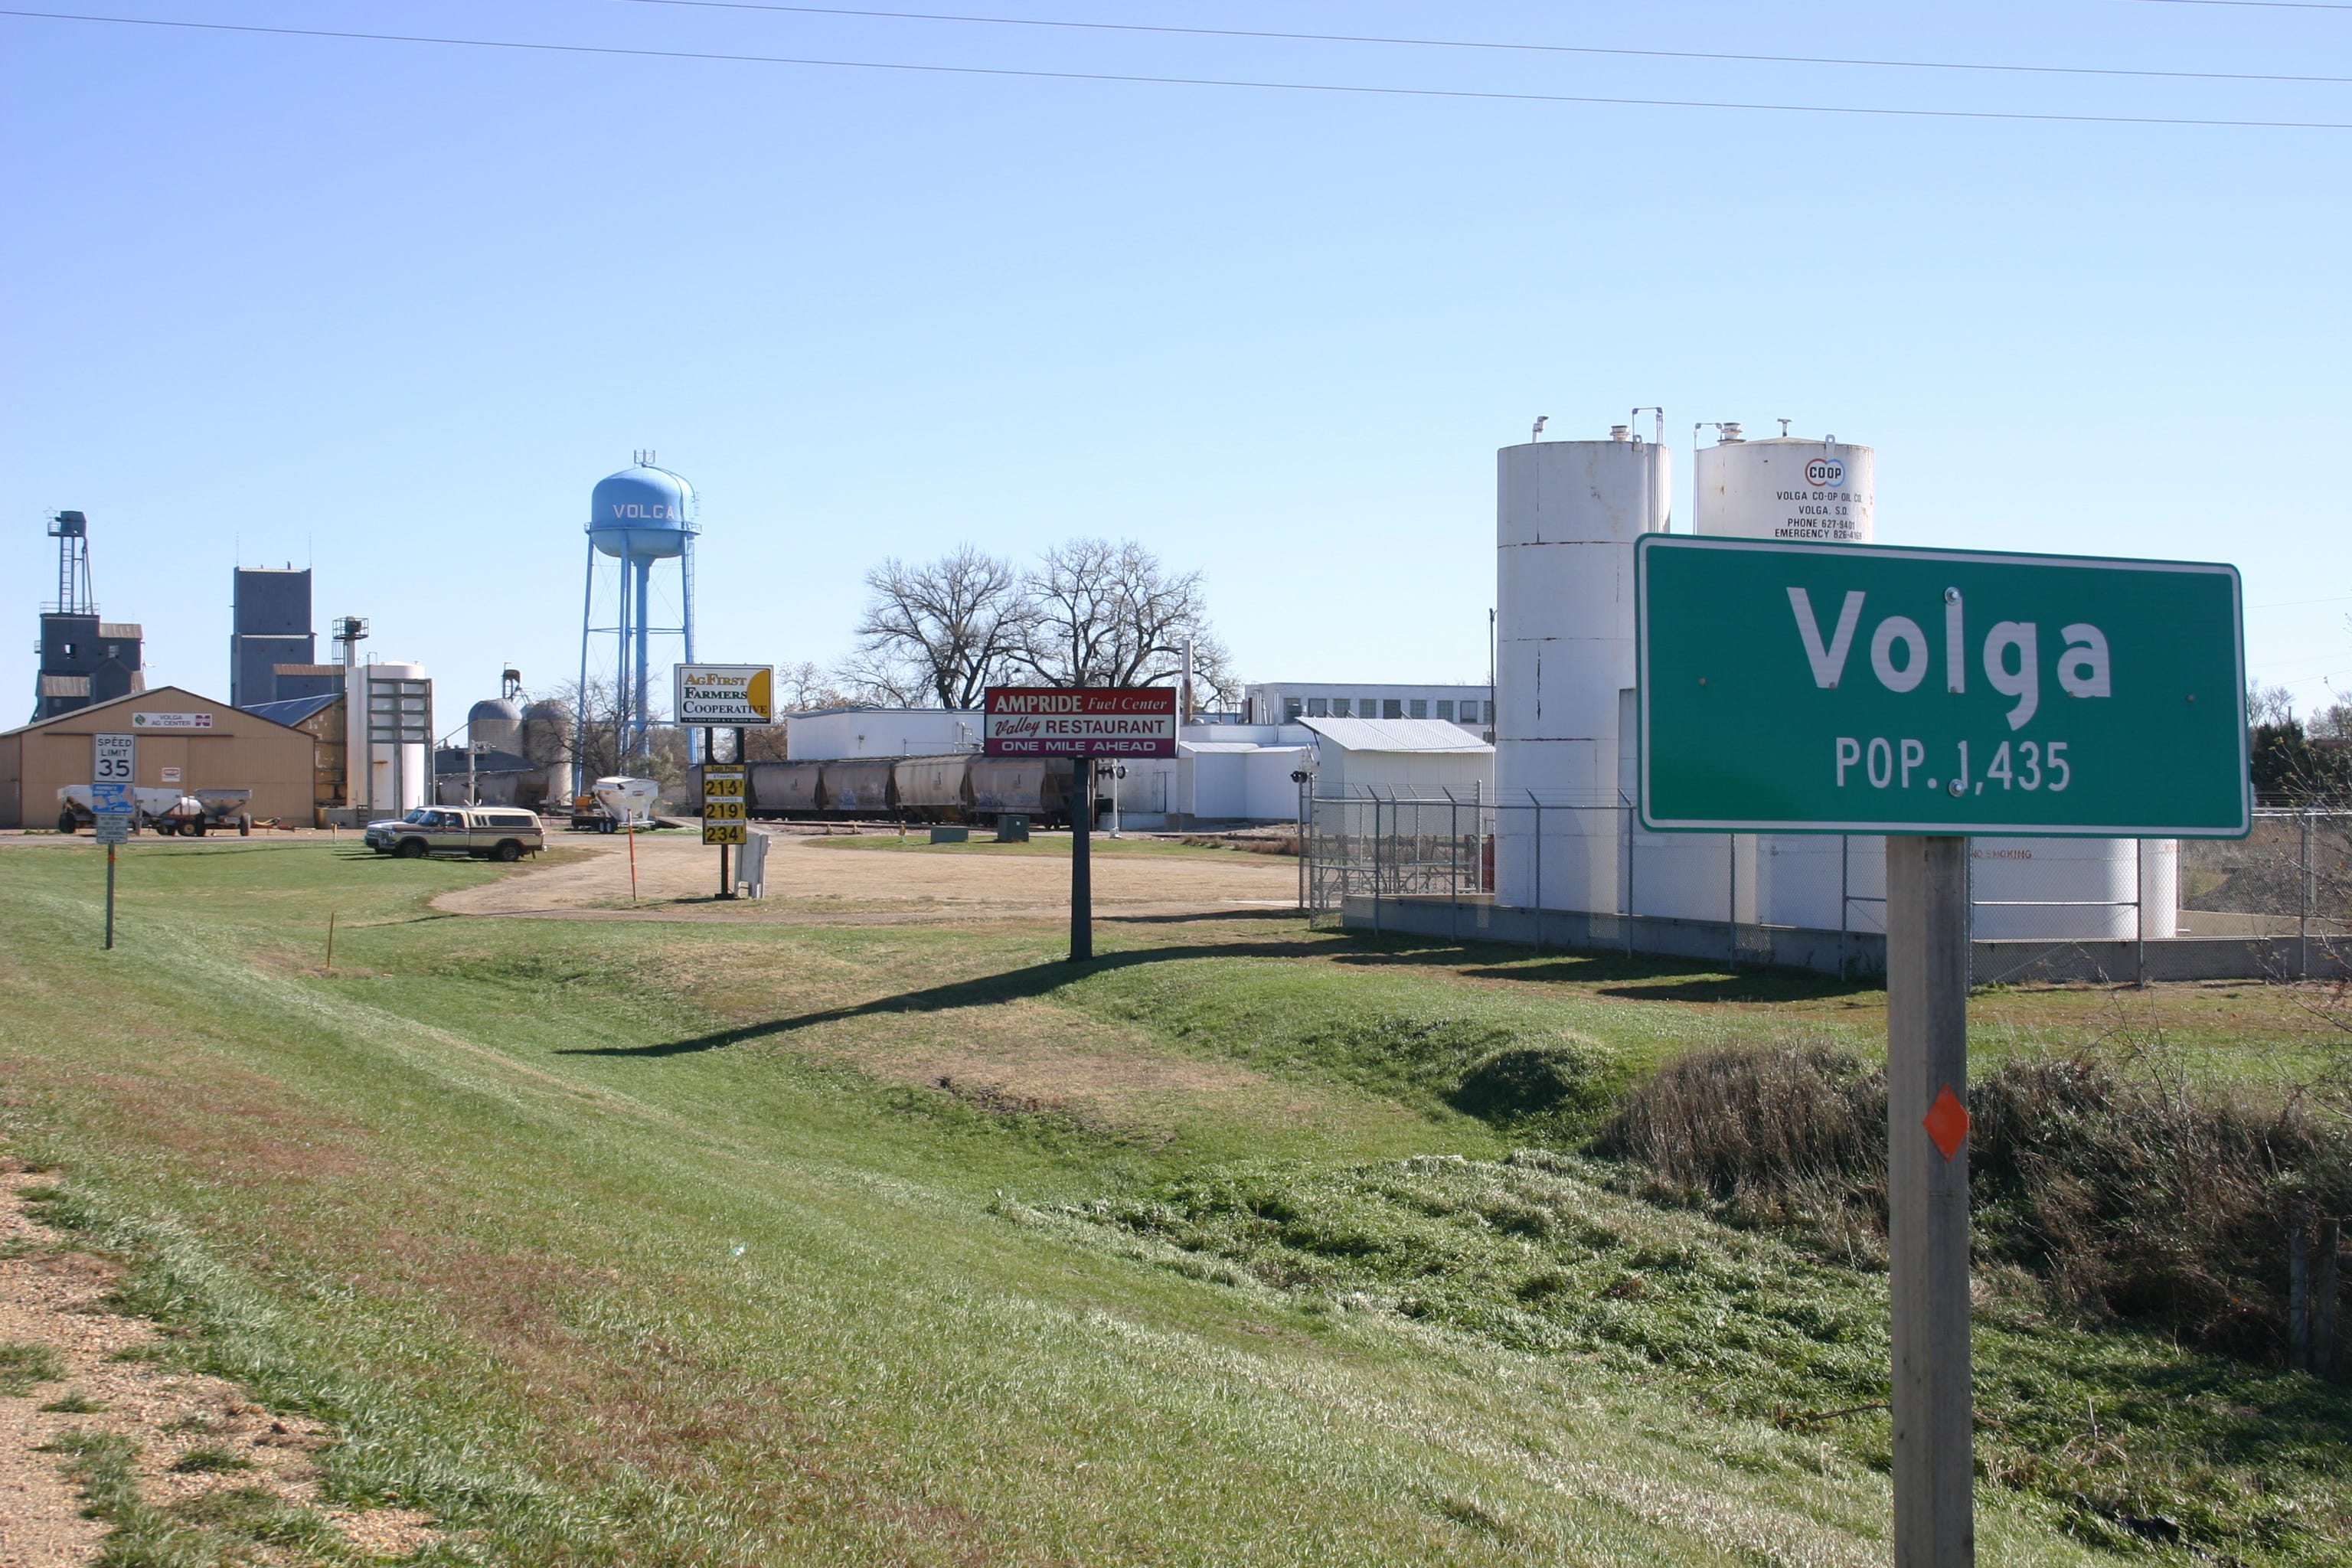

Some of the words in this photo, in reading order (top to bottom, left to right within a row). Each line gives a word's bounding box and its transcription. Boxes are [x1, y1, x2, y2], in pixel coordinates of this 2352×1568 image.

[1809, 466, 1841, 479] COOP
[1776, 491, 1808, 501] VOLGA
[1812, 492, 1838, 501] CO-OP
[1841, 492, 1851, 502] OIL
[612, 504, 675, 519] VOLGA
[1798, 505, 1831, 516] VOLGA,
[1787, 518, 1818, 528] PHONE
[1775, 528, 1829, 538] EMERGENCY
[1785, 586, 2112, 731] Volga
[683, 687, 748, 700] FARMERS
[683, 701, 768, 714] COOPERATIVE
[995, 695, 1083, 713] AMPRIDE
[1087, 697, 1116, 710] Fuel
[1122, 697, 1168, 710] Center
[995, 715, 1041, 737] Valley
[1045, 720, 1165, 734] RESTAURANT
[97, 738, 132, 747] SPEED
[1001, 741, 1039, 752] ONE
[1045, 741, 1086, 752] MILE
[1093, 741, 1156, 752] AHEAD
[99, 759, 130, 777] 35
[1836, 737, 1938, 789] POP.
[1953, 740, 2070, 795] 1,435
